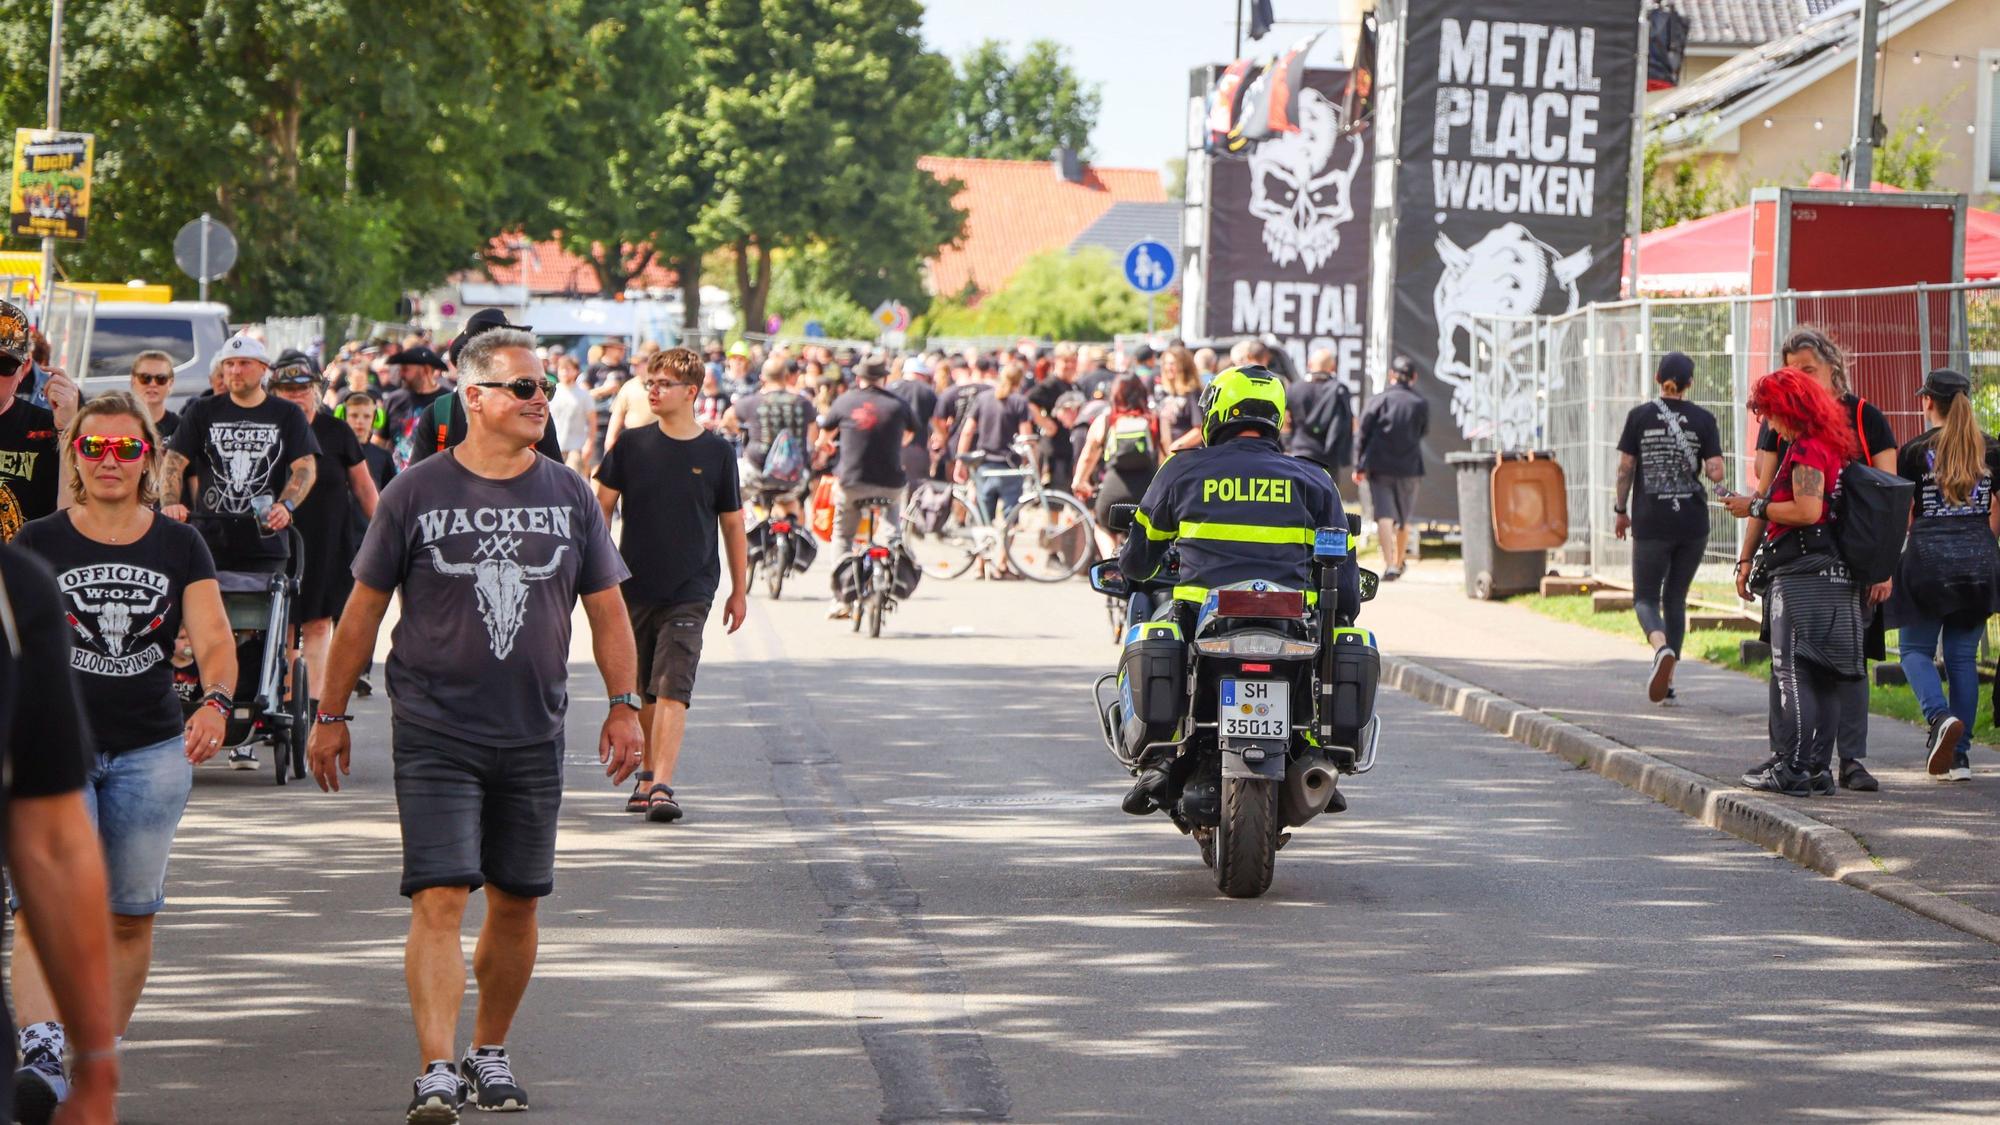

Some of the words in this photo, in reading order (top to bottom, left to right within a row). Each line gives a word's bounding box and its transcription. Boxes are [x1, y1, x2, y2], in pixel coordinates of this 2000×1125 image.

[1438, 18, 1602, 93] METAL
[1433, 87, 1601, 164] PLACE
[1432, 159, 1596, 218] WACKEN
[1232, 280, 1364, 336] METAL
[209, 427, 280, 445] WACKEN
[224, 441, 262, 450] 2024
[1203, 477, 1292, 504] POLIZEI
[417, 505, 573, 545] WACKEN
[64, 565, 164, 590] OFFICIAL
[84, 587, 150, 600] W:O:A
[72, 646, 162, 675] BLOODSPONSOR
[1225, 696, 1232, 704] D
[1244, 683, 1268, 699] SH
[1226, 718, 1283, 736] 35013
